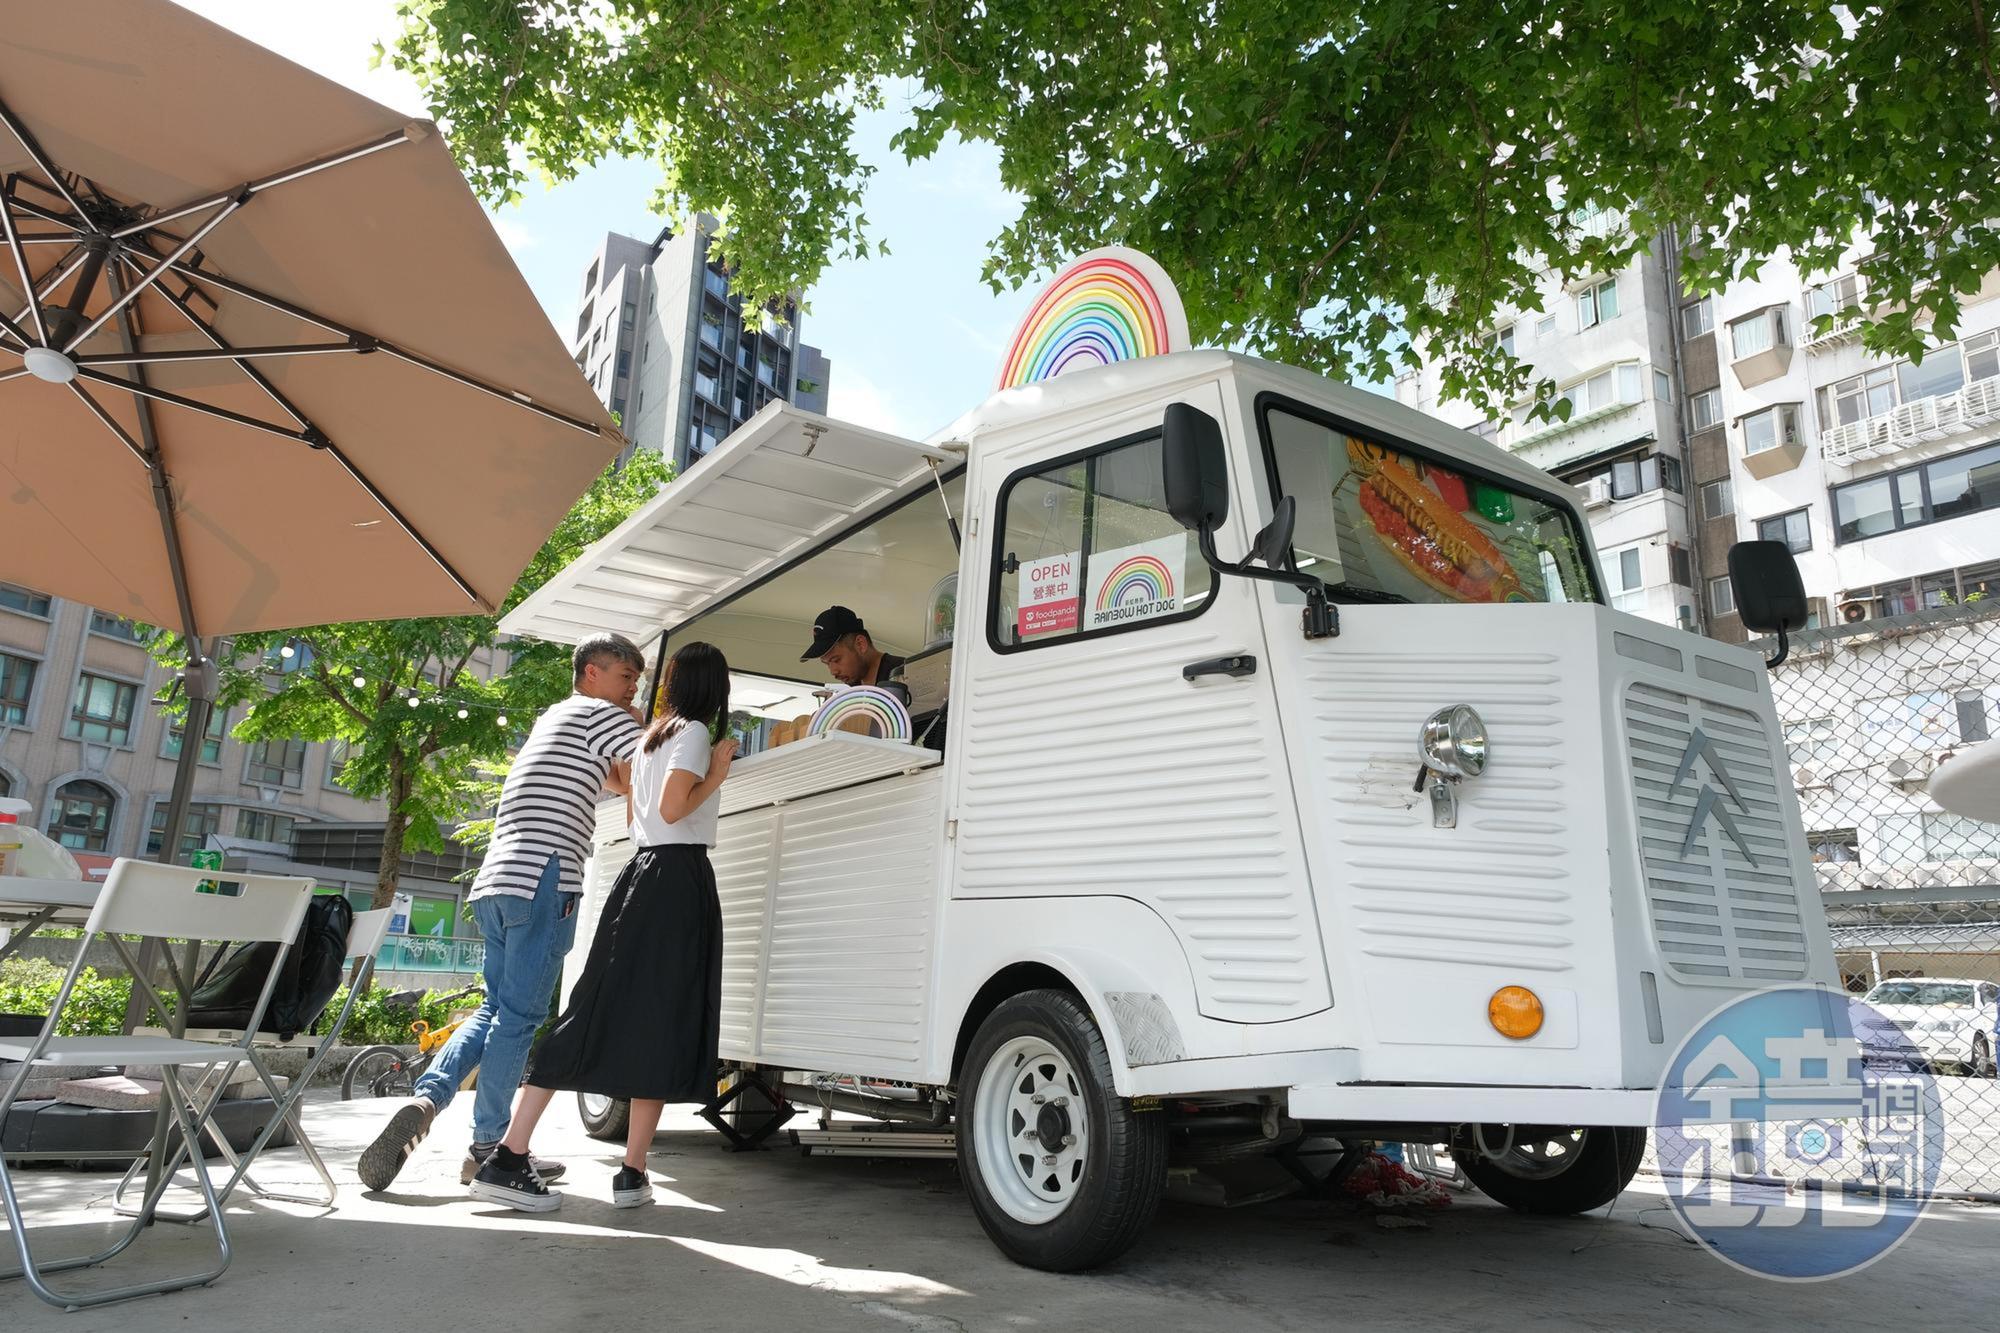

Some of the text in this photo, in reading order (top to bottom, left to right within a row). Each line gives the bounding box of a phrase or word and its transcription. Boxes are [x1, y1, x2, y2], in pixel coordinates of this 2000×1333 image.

[1031, 562, 1071, 582] OPEN
[1033, 581, 1069, 600] 營業中
[1035, 605, 1076, 619] foodpanda
[1094, 607, 1135, 624] RAINBOW
[1136, 602, 1155, 616] HOT
[1156, 598, 1175, 613] DOG
